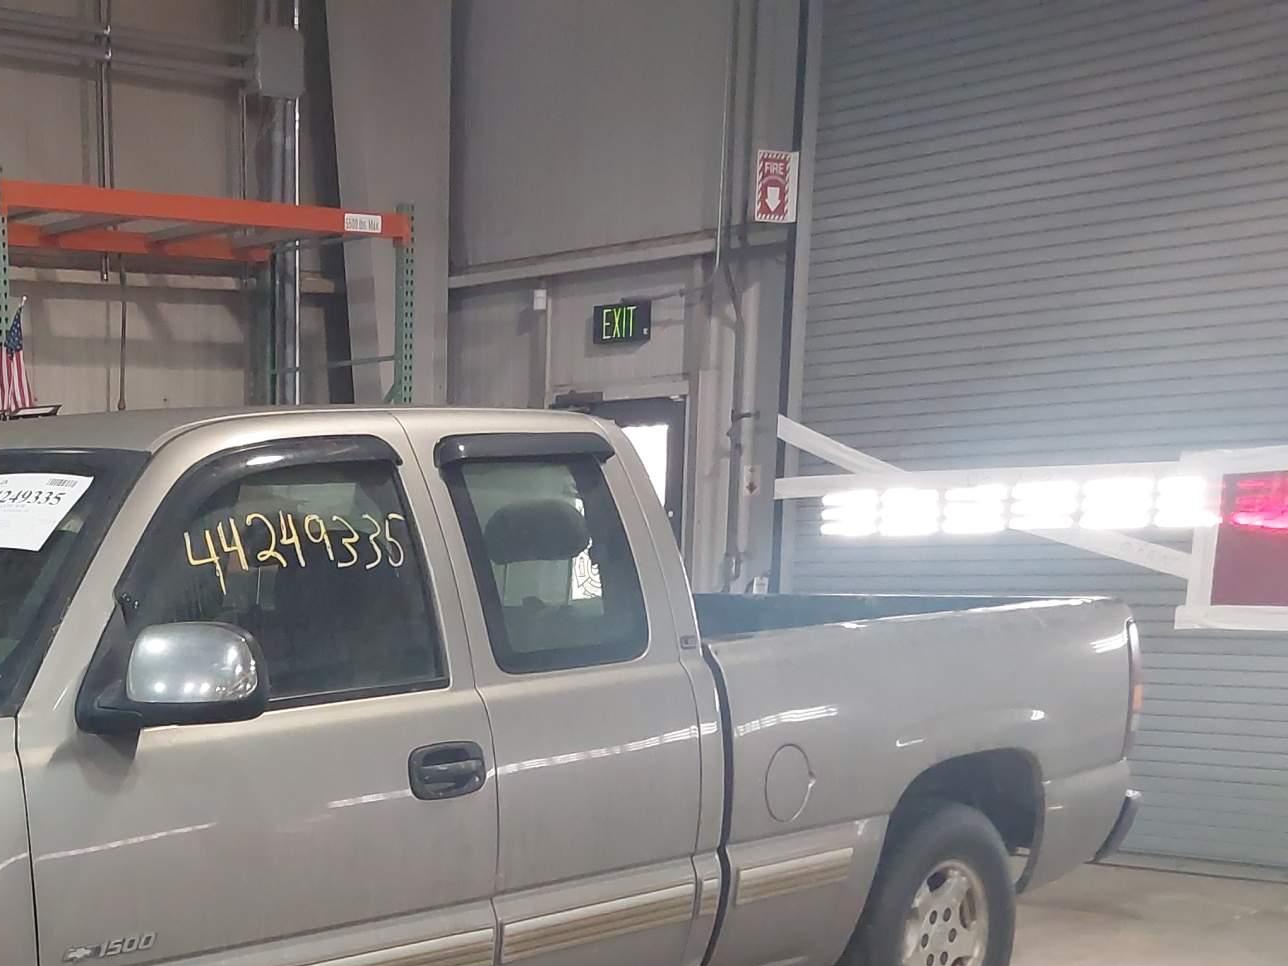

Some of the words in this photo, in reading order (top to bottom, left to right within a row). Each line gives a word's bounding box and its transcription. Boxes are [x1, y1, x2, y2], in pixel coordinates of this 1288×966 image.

[764, 162, 785, 175] FIRE
[602, 306, 637, 340] EXIT
[183, 510, 405, 596] 44249335
[99, 932, 156, 957] 1500
